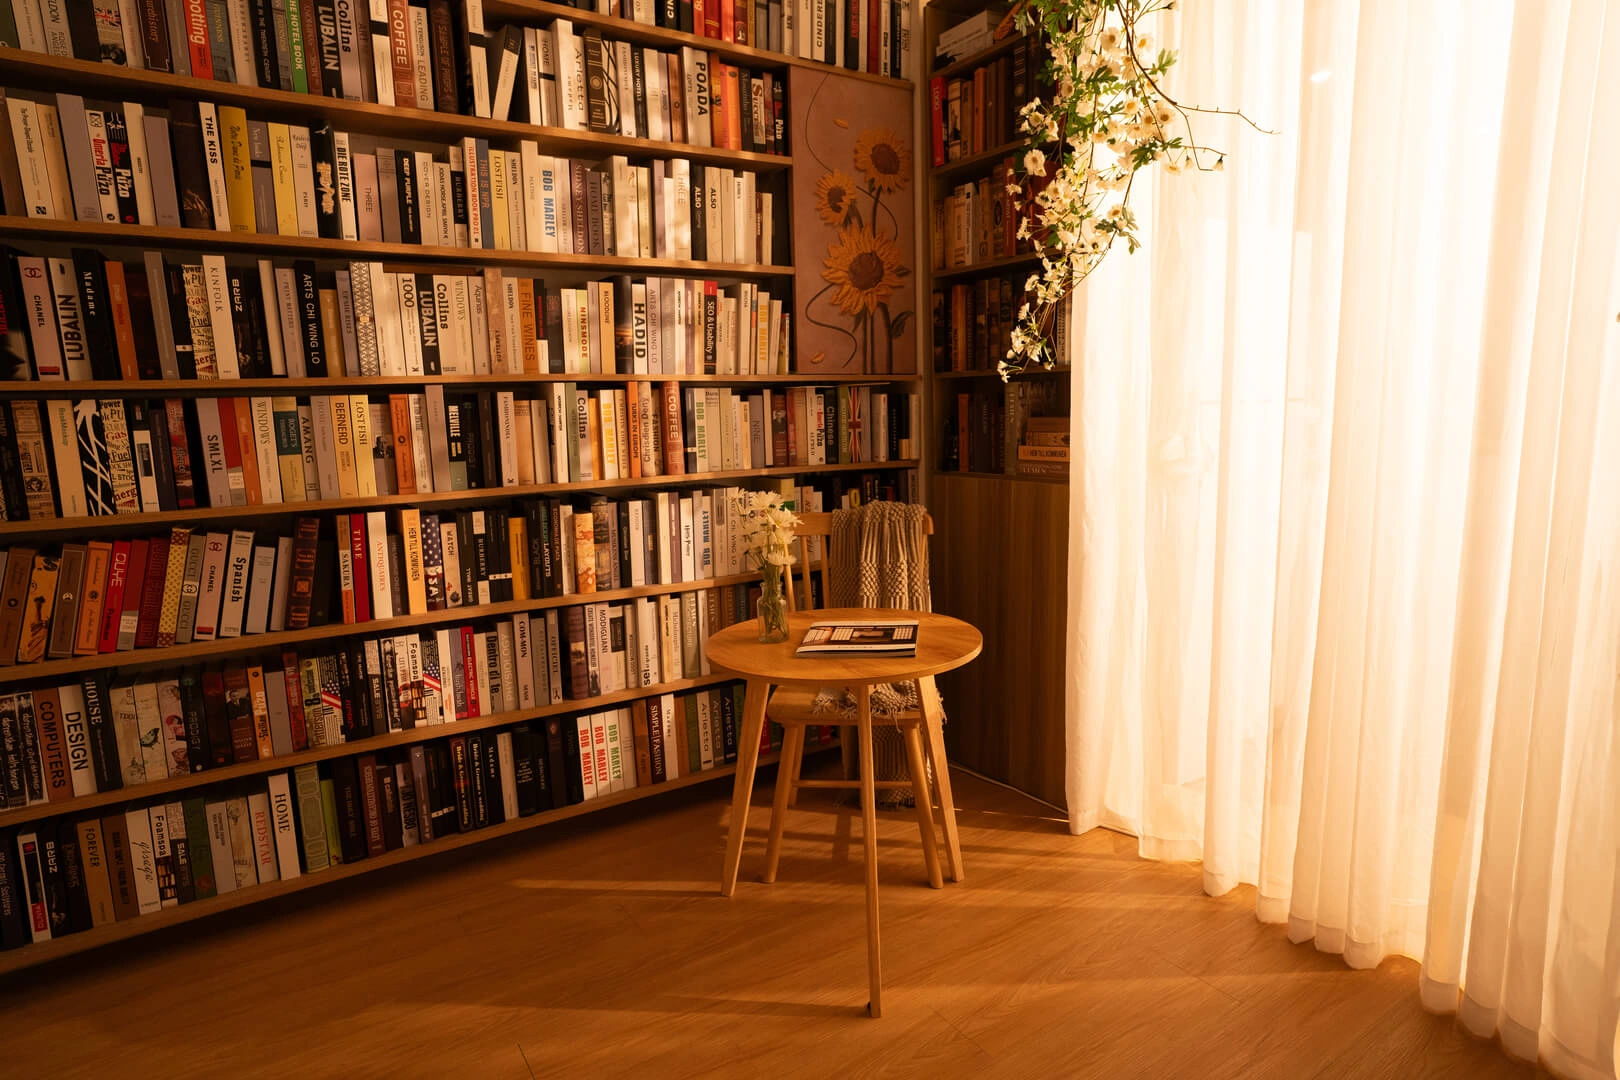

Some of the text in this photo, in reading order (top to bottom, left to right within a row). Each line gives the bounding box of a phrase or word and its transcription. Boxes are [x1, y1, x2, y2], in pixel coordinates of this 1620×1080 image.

[290, 14, 302, 69] HOTEL BOOK
[317, 5, 338, 71] LUBALIN
[335, 0, 355, 52] Collins
[392, 9, 407, 64] COFFEE
[415, 59, 430, 101] LEADING
[691, 61, 711, 115] POADA
[204, 116, 218, 164] THE KISS
[336, 146, 346, 159] DIE
[114, 167, 134, 199] Puzo
[478, 159, 488, 176] THIS
[480, 179, 488, 188] IS
[339, 181, 351, 202] ZONE
[364, 186, 373, 212] THREE
[542, 170, 555, 237] BOB MARLEY
[573, 164, 585, 253] SIDNEY SHELDON
[82, 270, 98, 317] Madame
[209, 266, 224, 312] KINFOLK
[402, 277, 414, 308] 1000
[436, 283, 449, 329] Collins
[454, 280, 465, 320] WINDOWS
[706, 301, 714, 315] SEO
[32, 294, 45, 327] CHANEL
[57, 292, 84, 362] LUBALIN
[301, 273, 320, 364] ARTS CHI WING LO
[419, 289, 436, 347] LUBALIN
[520, 291, 535, 361] FINE WINES
[632, 302, 647, 358] HADID
[579, 306, 587, 358] NINSMODE
[705, 323, 714, 353] Usability
[651, 353, 656, 363] LO
[106, 431, 127, 440] Gas
[255, 400, 270, 444] WINDOWS
[334, 401, 349, 445] BERNERD
[446, 404, 461, 437] MELVILLE
[577, 397, 587, 438] Collins
[651, 413, 659, 452] FASHION
[668, 395, 678, 438] COFFEE
[695, 401, 706, 459] BOB MARLEY
[112, 447, 130, 460] Fuel
[206, 433, 223, 474] SMLXL
[186, 547, 199, 577] GUCCI
[353, 528, 362, 559] TIME
[206, 564, 216, 593] CHANEL
[227, 556, 247, 603] Spanish
[341, 553, 350, 587] SAKURA
[178, 599, 191, 630] GUCCI
[598, 609, 608, 653] MODIGLIANI
[409, 642, 418, 679] Foamspa
[485, 636, 499, 666] Dentro
[498, 633, 513, 701] PHYSIOLOGY
[84, 680, 102, 725] HOUSE
[490, 684, 501, 693] te
[38, 700, 66, 789] COMPUTERS
[64, 710, 88, 770] DESIGN
[578, 728, 595, 785] BOB MARLEY
[593, 725, 609, 782] BOB MARLEY
[606, 724, 623, 780] BOB MARLEY
[274, 793, 290, 833] HOME
[84, 827, 100, 868] FOREVER
[154, 814, 168, 856] Foamspa
[176, 841, 188, 865] SALE
[253, 810, 272, 865] REDSTAR
